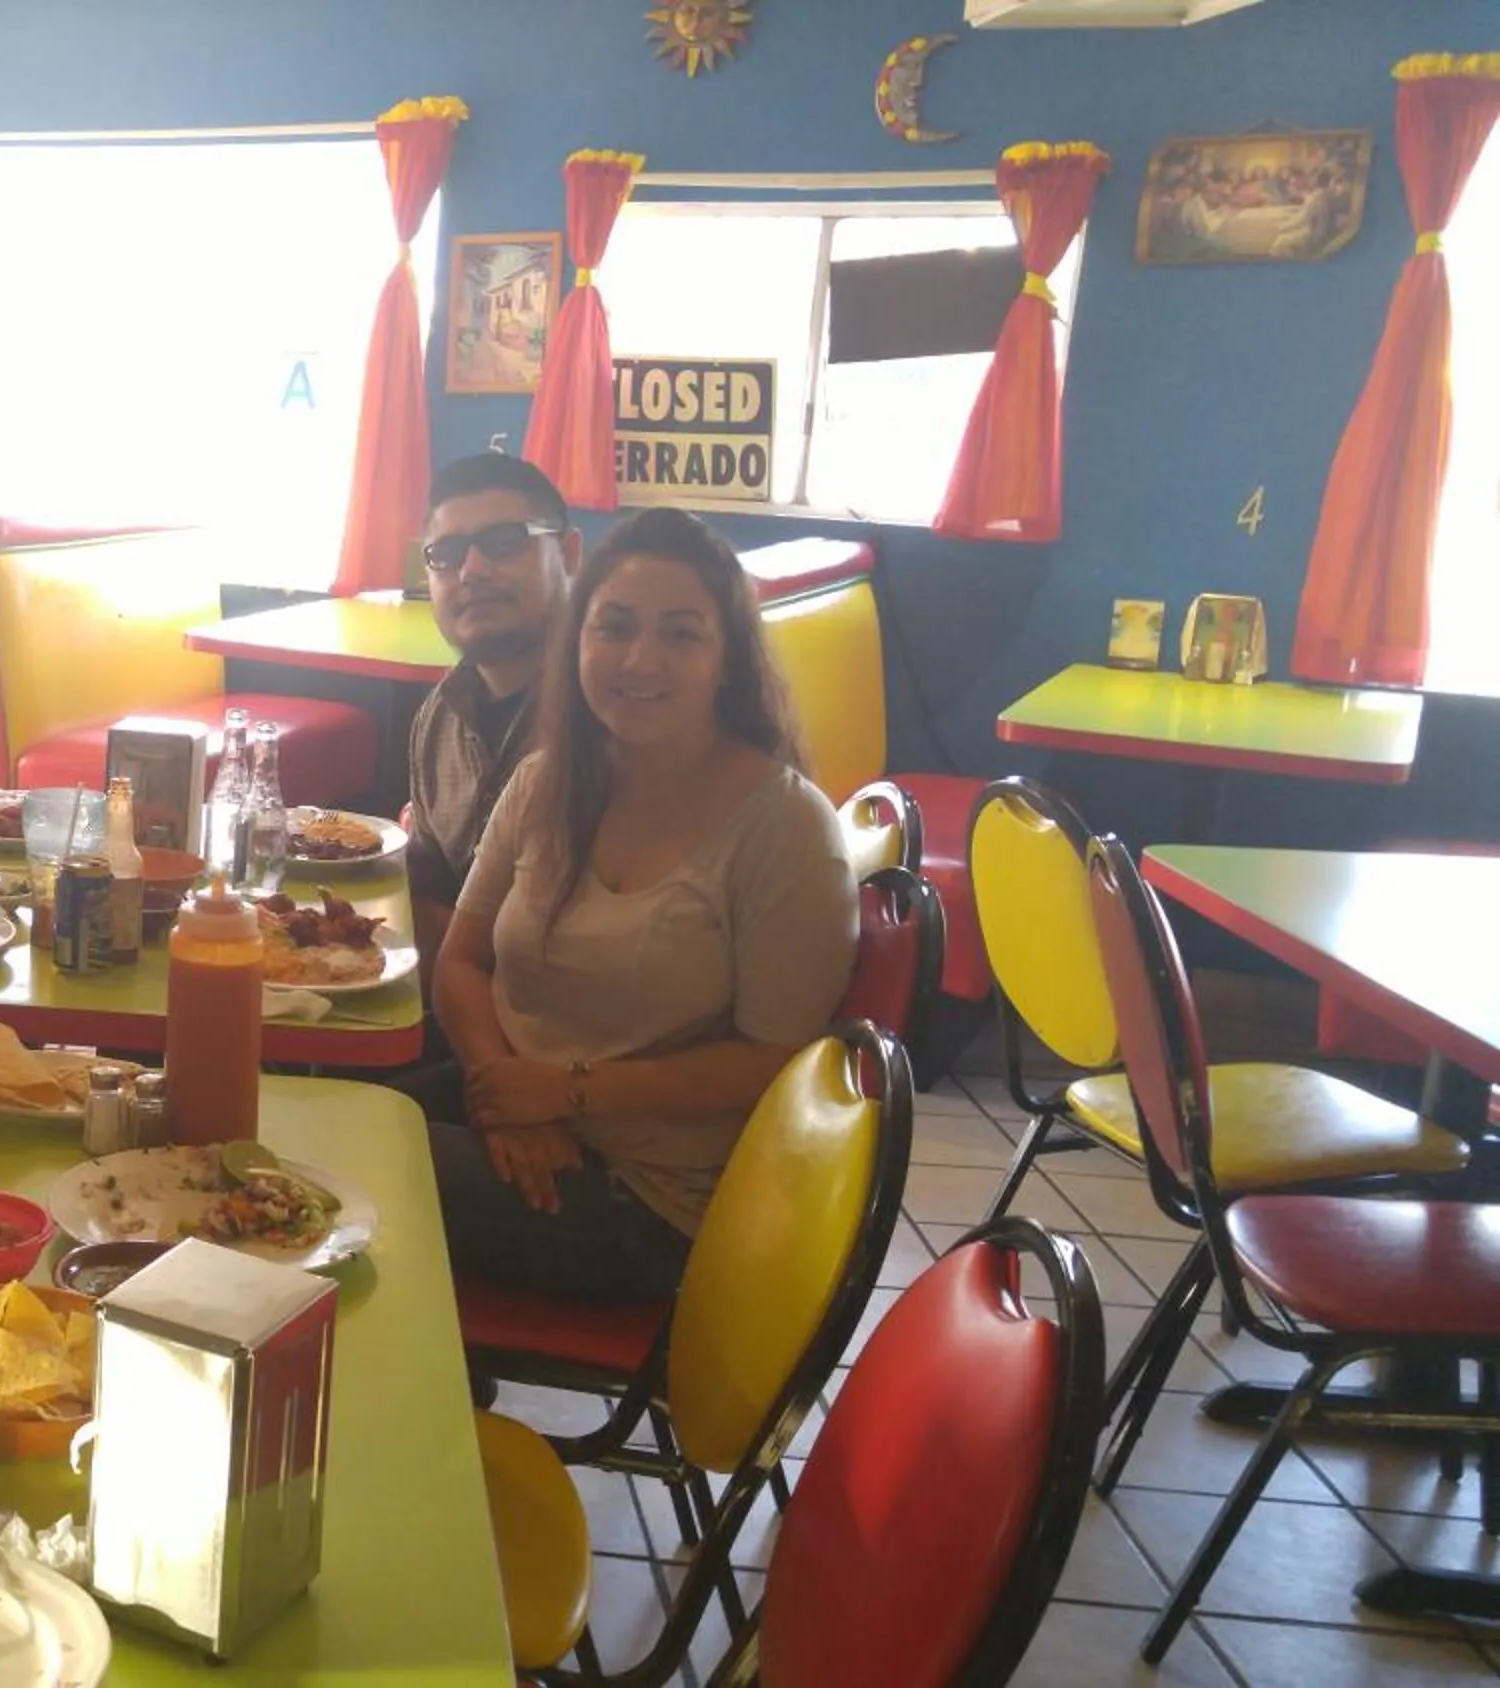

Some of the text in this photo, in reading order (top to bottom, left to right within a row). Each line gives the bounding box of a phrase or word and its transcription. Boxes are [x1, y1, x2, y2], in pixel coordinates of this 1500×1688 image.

[280, 359, 316, 410] A
[611, 367, 762, 423] LOSED
[613, 440, 767, 488] ERRADO
[1236, 485, 1264, 536] 4
